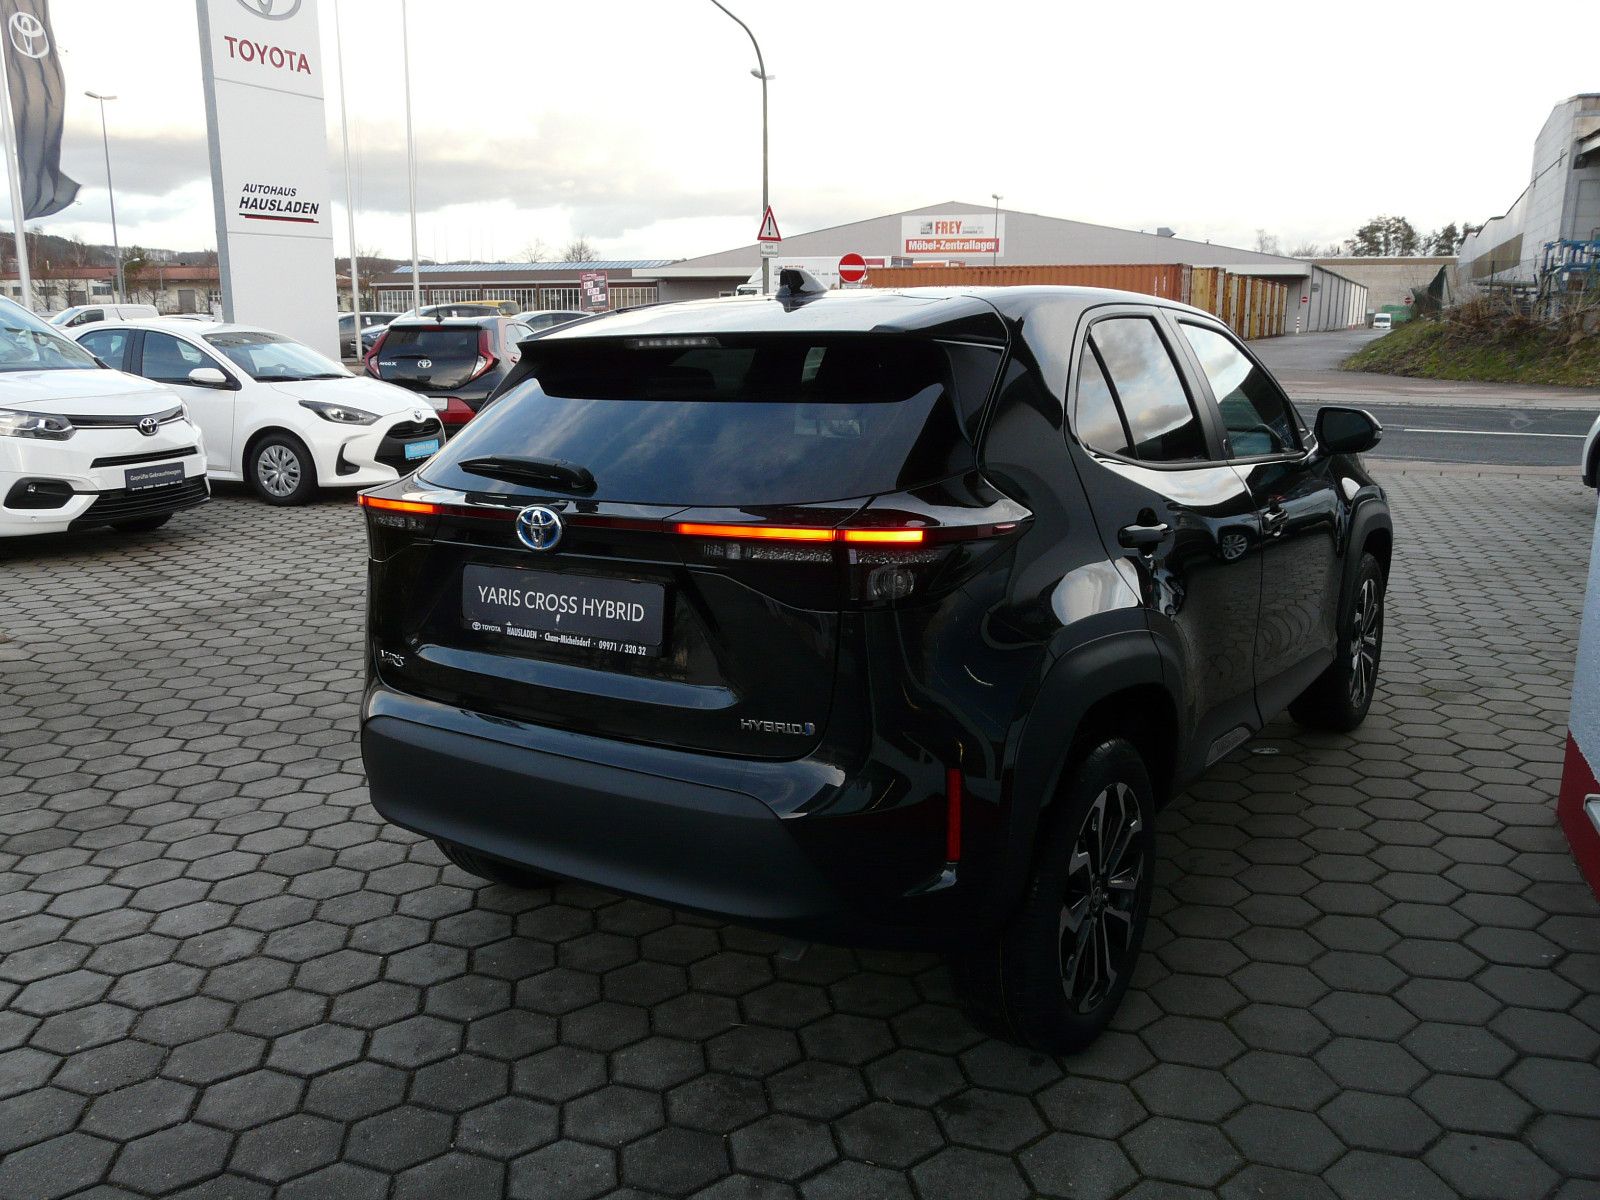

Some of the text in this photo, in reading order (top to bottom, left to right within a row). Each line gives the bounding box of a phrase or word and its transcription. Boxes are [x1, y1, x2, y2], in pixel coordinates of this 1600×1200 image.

[224, 35, 311, 75] TOYOTA
[242, 183, 297, 197] AUTOHAUS
[239, 196, 320, 215] HAUSLADEN
[935, 221, 962, 235] FREY
[908, 240, 996, 252] Möbel-Zentrallager
[478, 585, 645, 623] YARIS CROSS HYBRID
[482, 624, 501, 633] TOYOTA
[506, 626, 538, 640] HAUSLADEN
[544, 632, 592, 648] Cham-Michelsdorf
[598, 641, 618, 652] 09971
[624, 643, 637, 655] 320
[637, 646, 647, 656] 32
[740, 718, 803, 735] HYBRID
